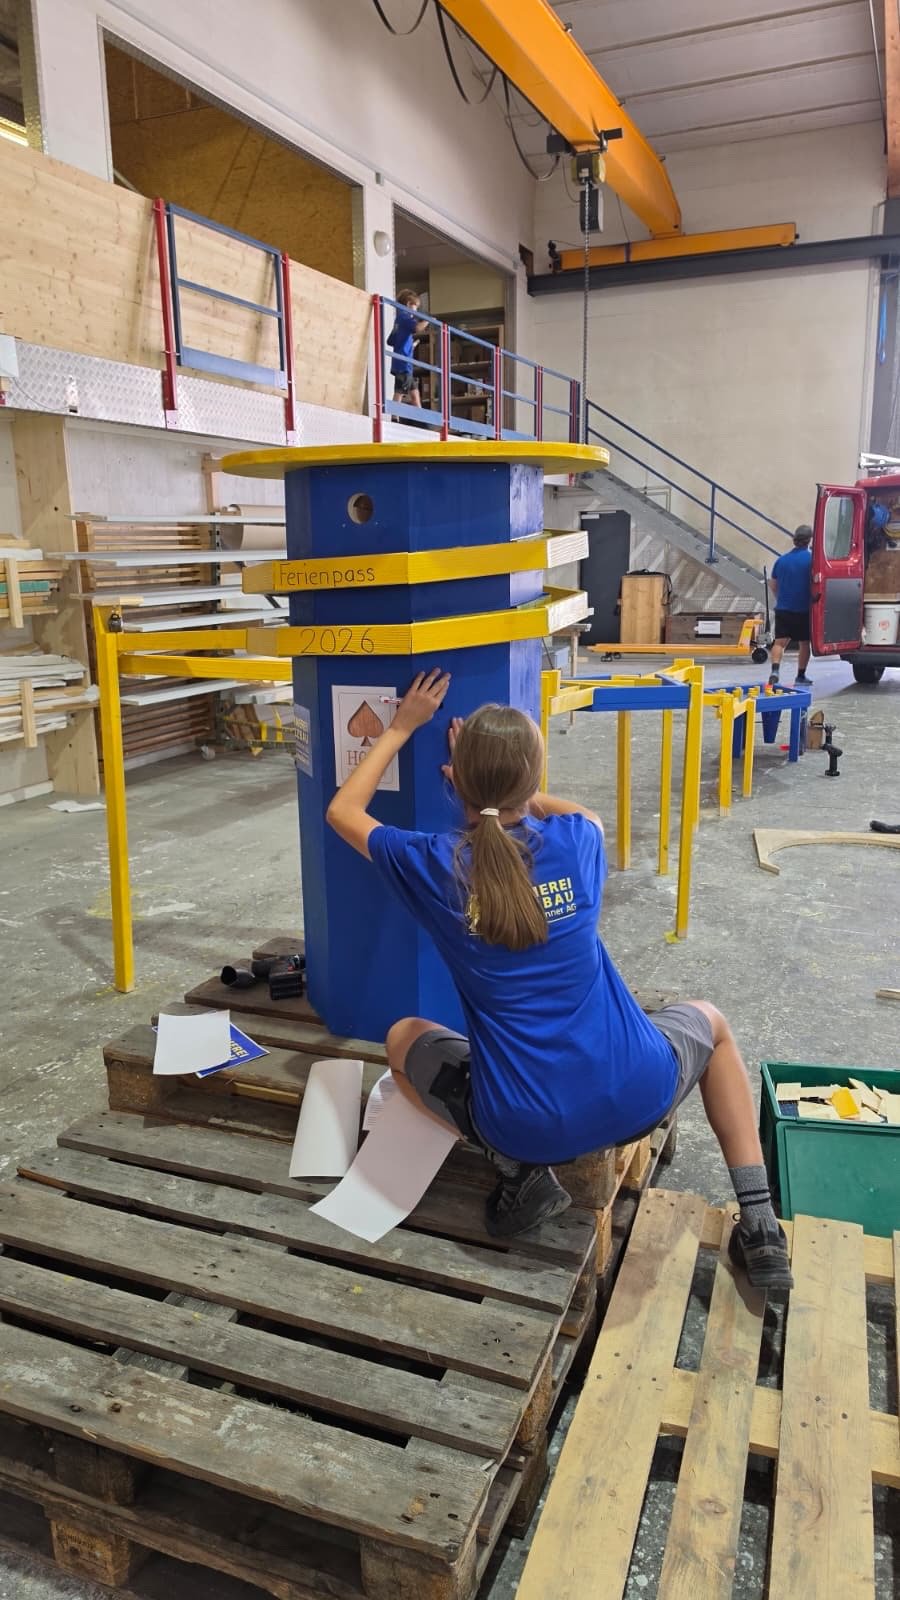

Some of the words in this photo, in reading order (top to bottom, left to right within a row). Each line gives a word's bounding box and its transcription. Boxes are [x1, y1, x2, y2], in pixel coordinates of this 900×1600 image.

[279, 562, 375, 588] Ferienpass
[300, 627, 375, 654] 2026
[346, 750, 367, 766] HO
[543, 890, 574, 909] BAU
